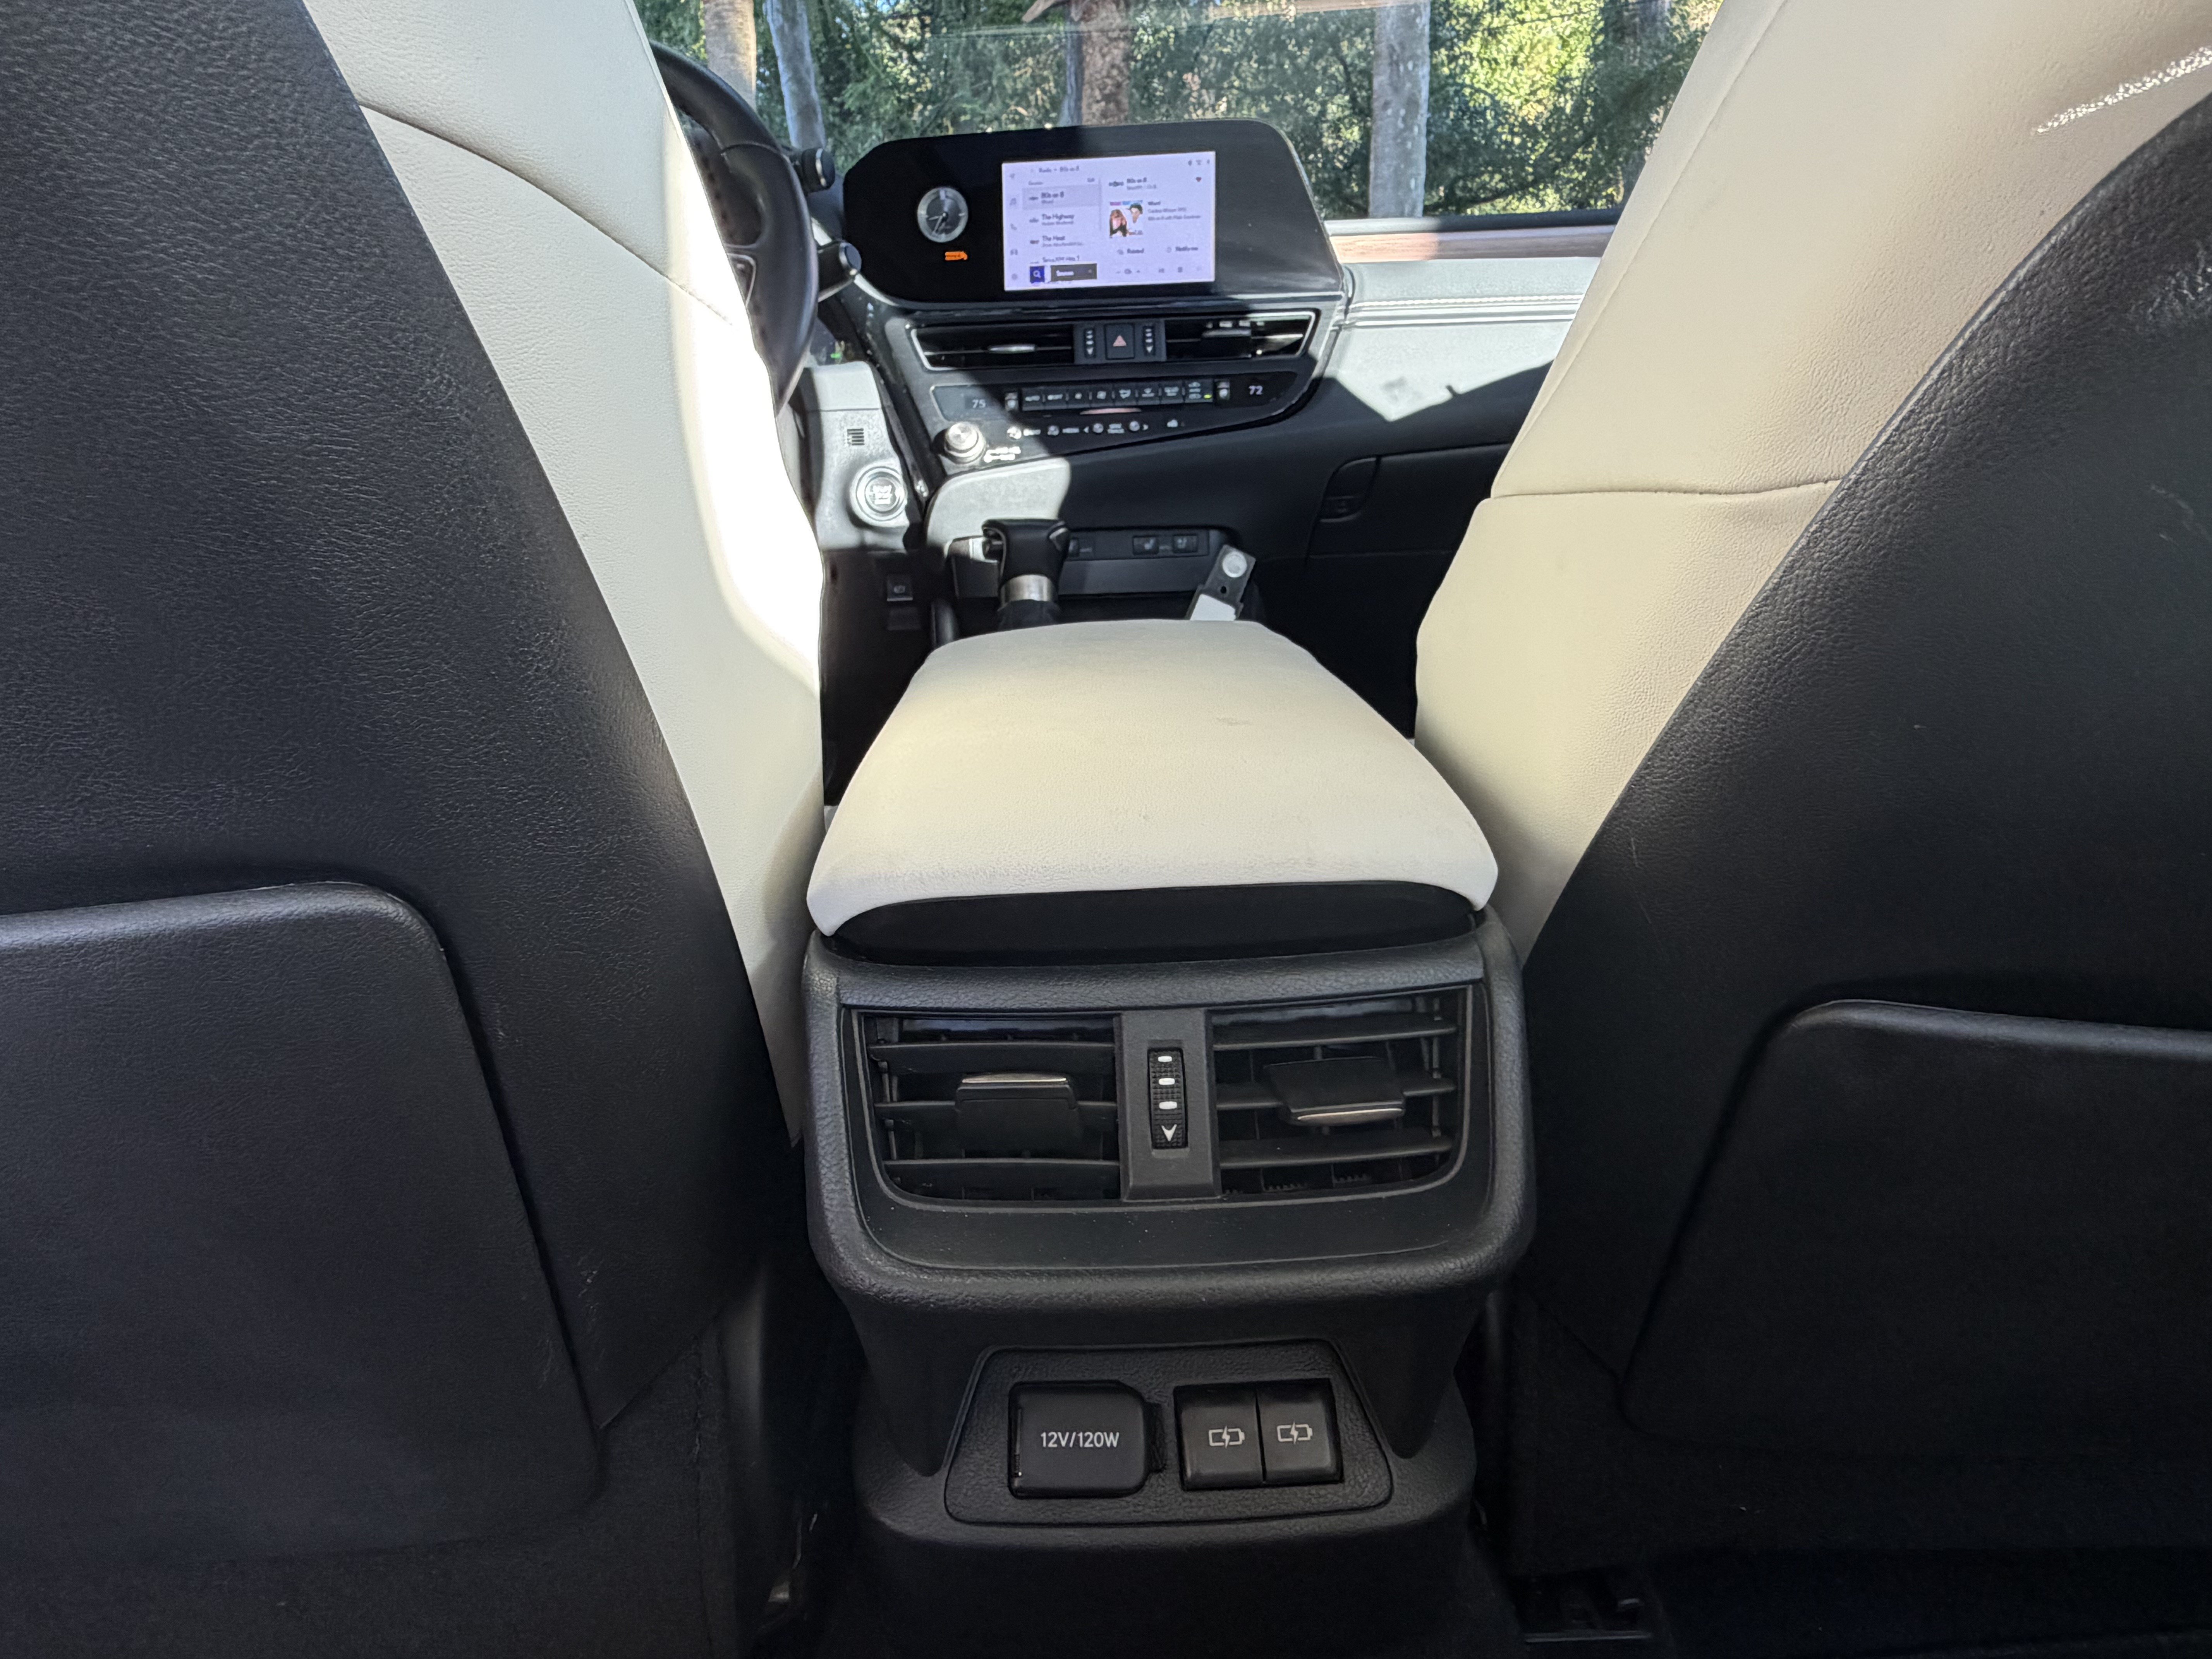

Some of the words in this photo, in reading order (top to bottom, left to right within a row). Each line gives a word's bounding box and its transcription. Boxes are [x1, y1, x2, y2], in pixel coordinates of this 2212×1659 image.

[1249, 386, 1264, 395] 72
[972, 399, 986, 409] 75
[1040, 1431, 1120, 1448] 12V/120W
